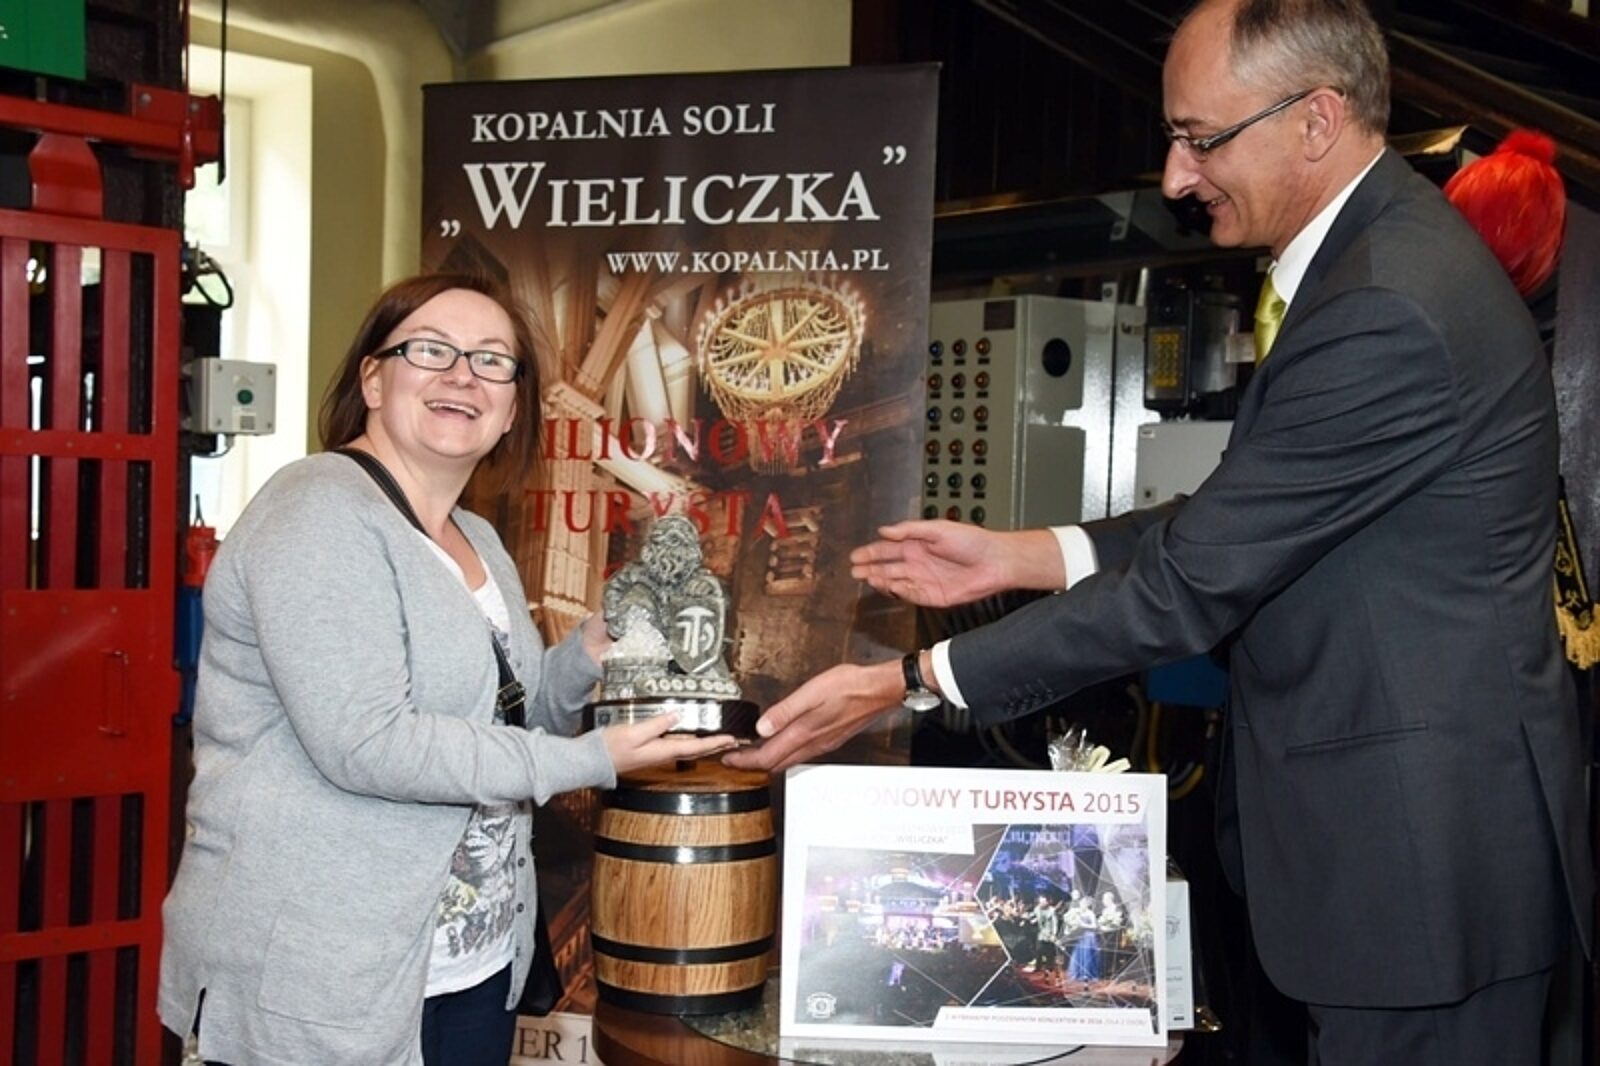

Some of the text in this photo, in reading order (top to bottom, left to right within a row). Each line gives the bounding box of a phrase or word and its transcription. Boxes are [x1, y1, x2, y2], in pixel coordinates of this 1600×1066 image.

[472, 103, 777, 142] KOPALNIA SOLI
[606, 249, 890, 274] WWW.KOPALNIA.PL
[543, 417, 848, 465] ILIONOWY
[969, 789, 1075, 812] TURYSTA
[1083, 792, 1140, 815] 2015
